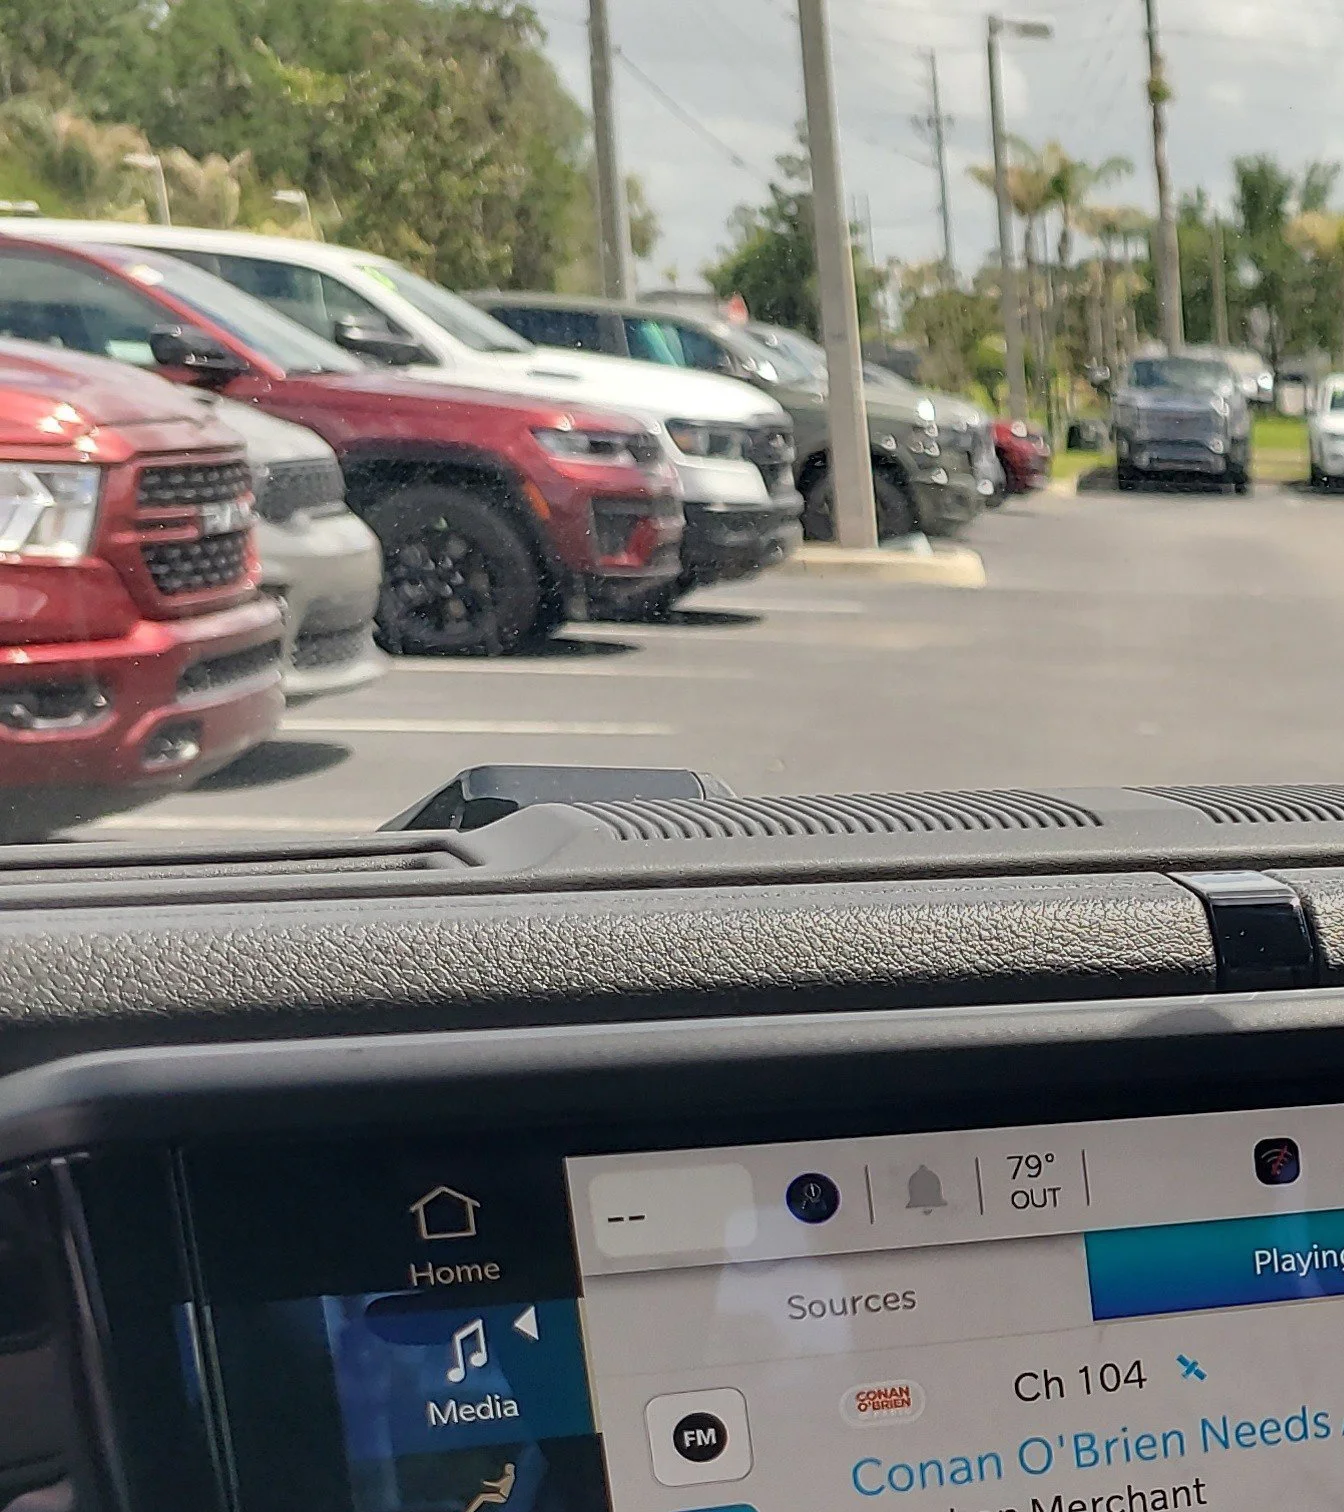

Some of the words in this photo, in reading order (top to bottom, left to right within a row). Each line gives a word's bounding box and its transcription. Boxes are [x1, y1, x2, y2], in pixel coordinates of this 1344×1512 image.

[1007, 1152, 1055, 1181] 79°
[1011, 1187, 1061, 1210] OUT
[410, 1262, 500, 1286] Home
[787, 1286, 917, 1321] Sources
[856, 1385, 910, 1402] CONAN
[1014, 1373, 1065, 1403] Ch
[1077, 1359, 1148, 1395] 104
[428, 1396, 519, 1426] Media
[857, 1398, 911, 1412] O'BRIEN
[683, 1428, 717, 1448] FM
[852, 1450, 1003, 1498] Conan
[1018, 1430, 1187, 1477] O'Brien
[1200, 1405, 1333, 1452] Needs
